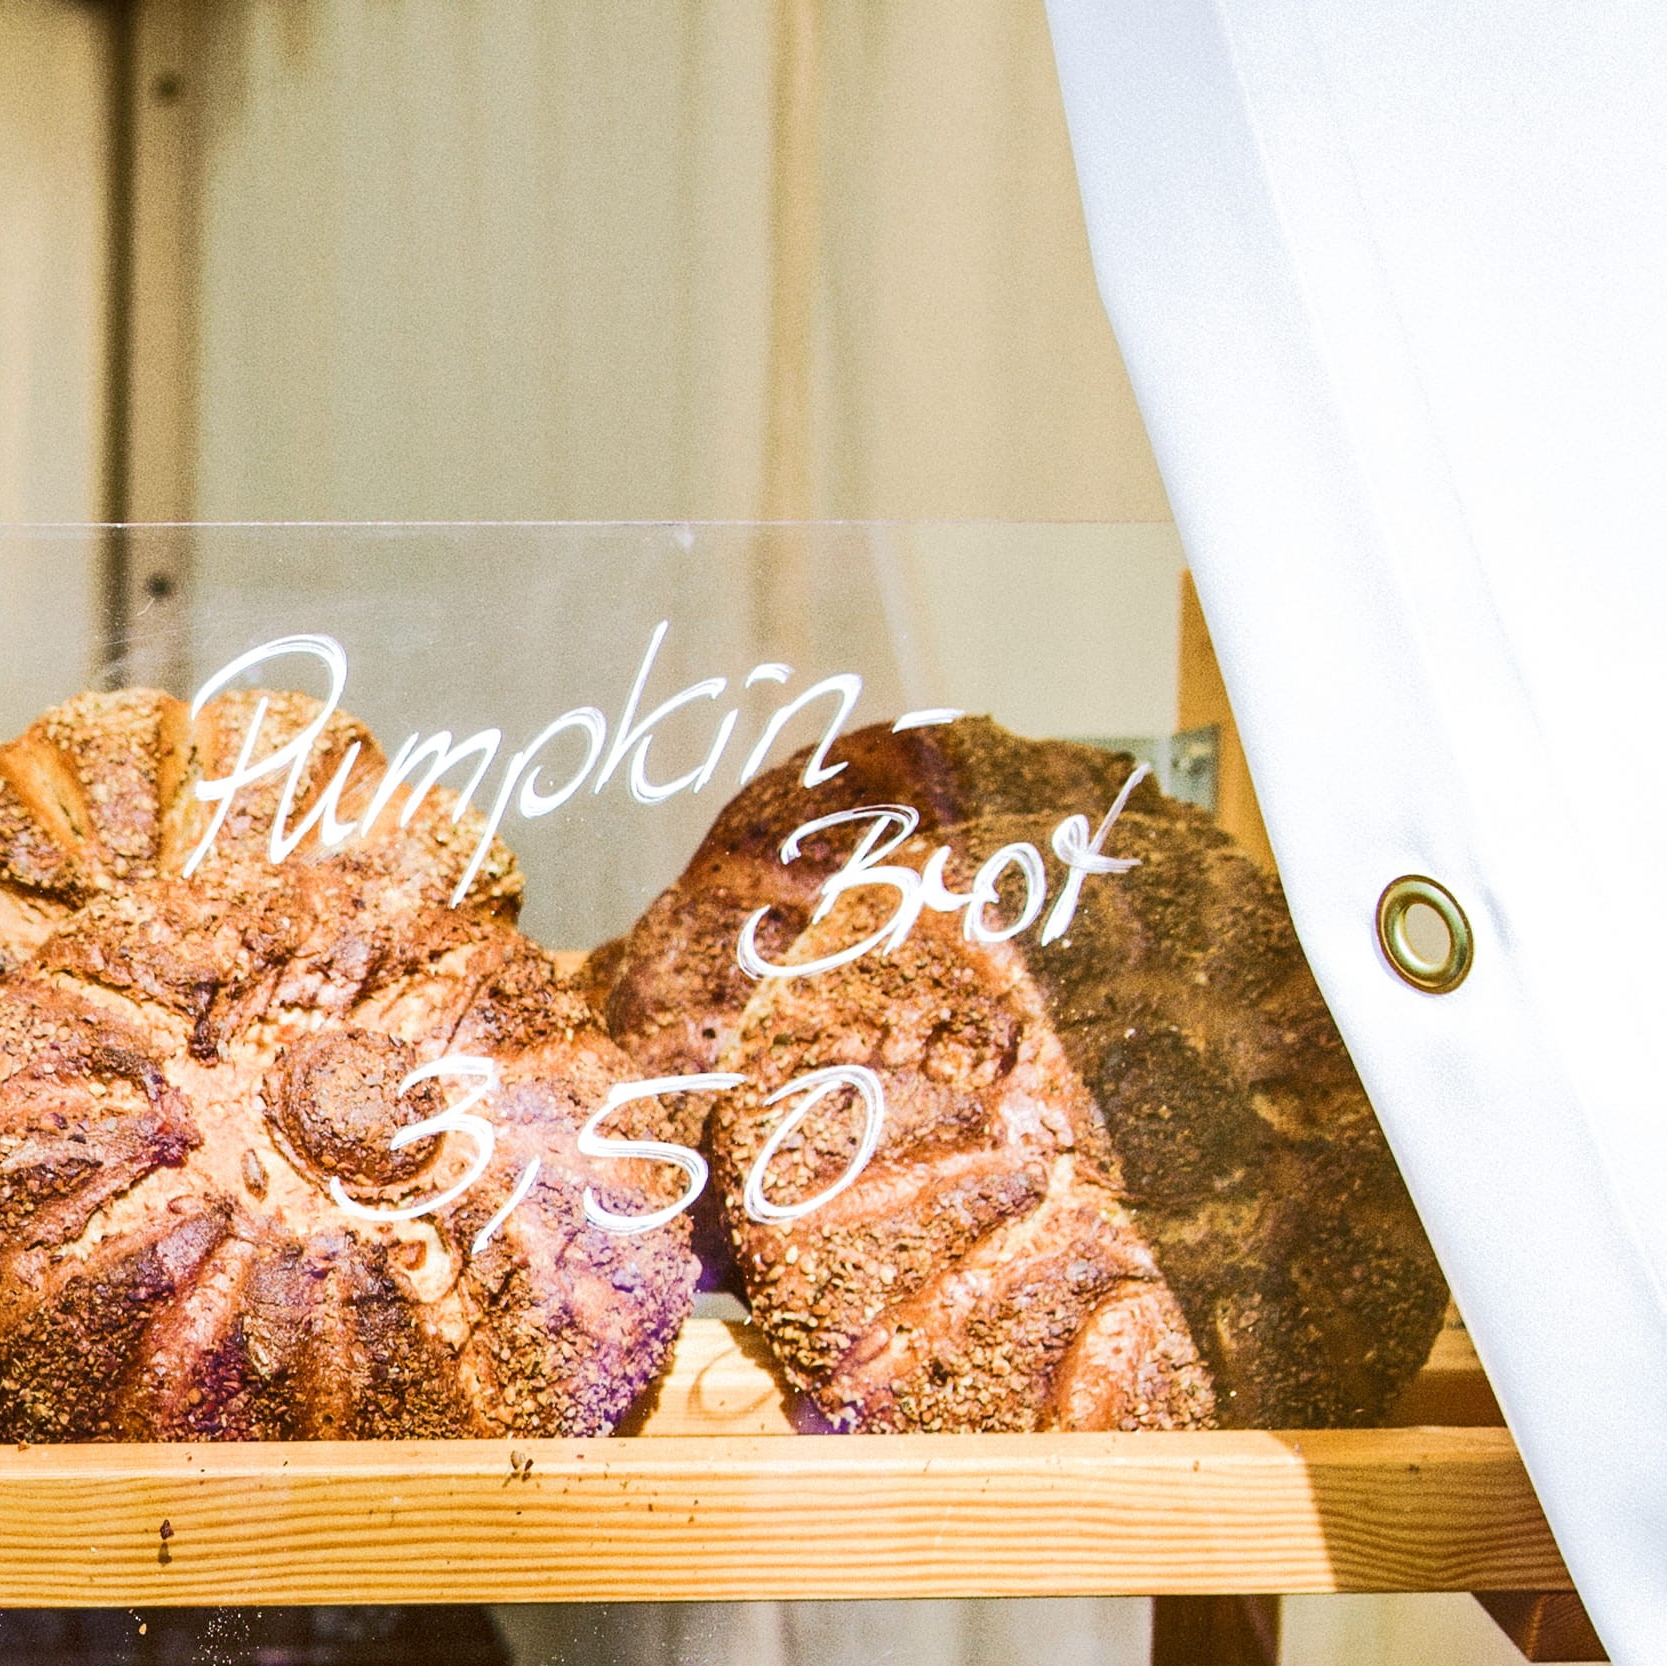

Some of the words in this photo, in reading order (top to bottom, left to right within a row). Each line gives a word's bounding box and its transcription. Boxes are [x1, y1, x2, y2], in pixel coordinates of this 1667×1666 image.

[181, 620, 965, 909] Pumpkin-
[737, 764, 1150, 981] Brot
[329, 1056, 886, 1254] 3,50
